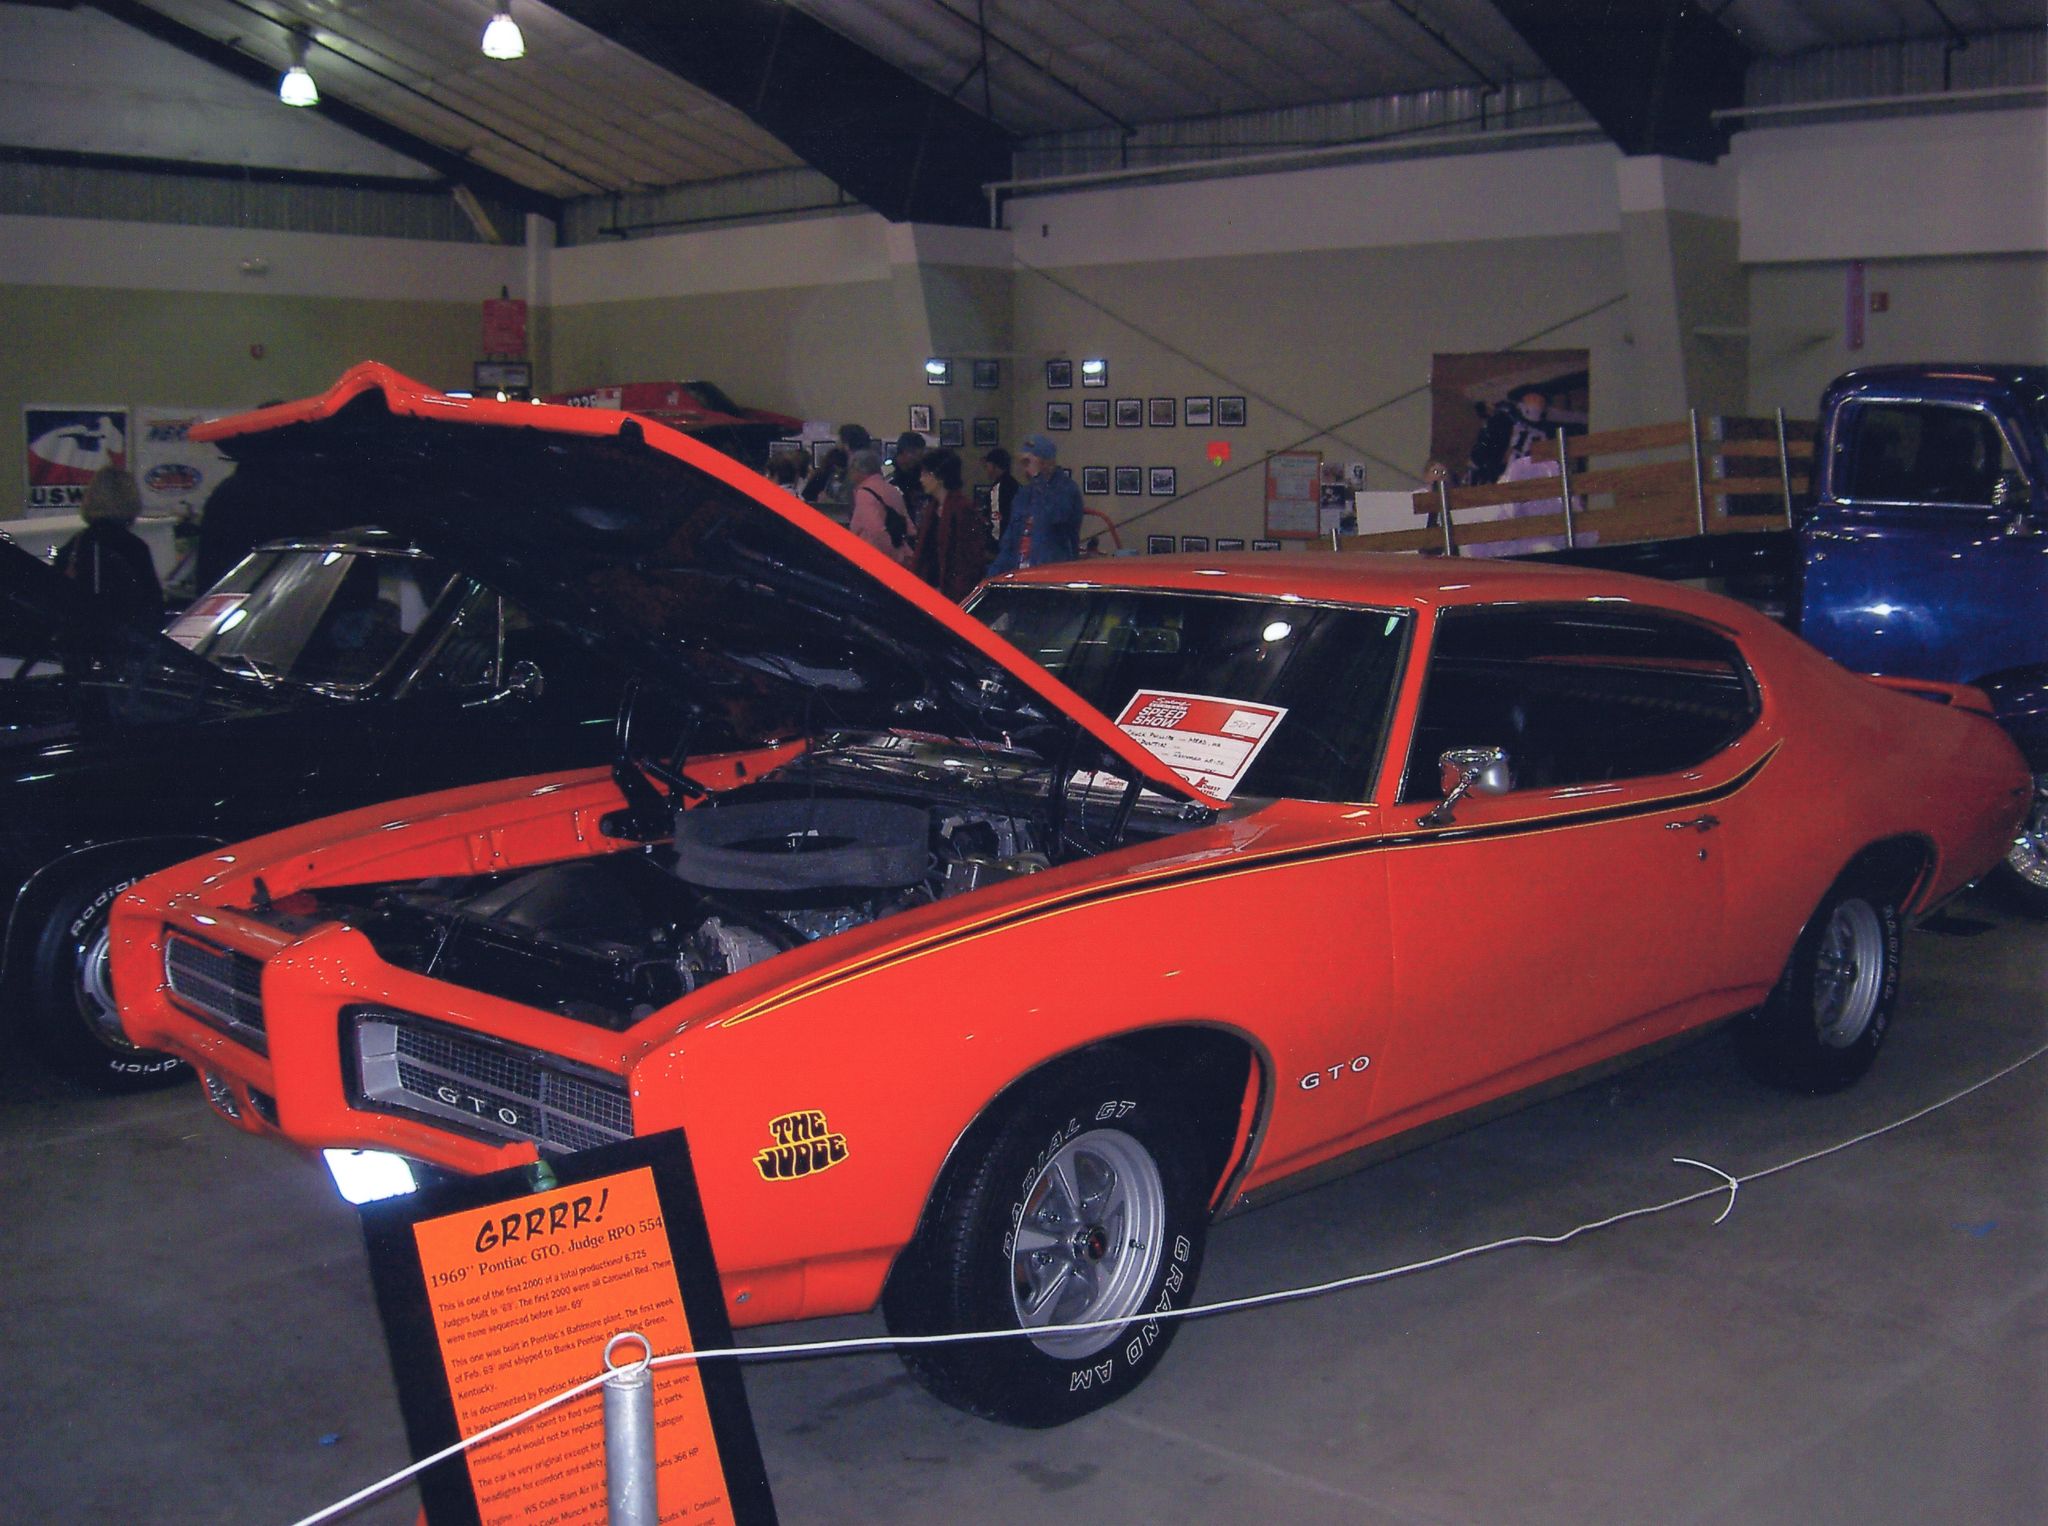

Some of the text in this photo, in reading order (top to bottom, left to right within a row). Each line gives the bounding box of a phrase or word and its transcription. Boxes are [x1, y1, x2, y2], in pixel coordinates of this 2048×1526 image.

[1132, 715, 1180, 728] SHOW
[1139, 706, 1187, 720] SPEED
[1300, 1055, 1370, 1091] GTO
[438, 1086, 518, 1125] GTO
[769, 1109, 828, 1146] THE
[752, 1132, 850, 1181] JUDGE
[1002, 1100, 1136, 1259] RADIAL GT
[474, 1188, 609, 1253] GRRRR!
[478, 1250, 528, 1276] Pontiac
[566, 1230, 605, 1254] Judge
[607, 1222, 636, 1241] RPO
[638, 1215, 663, 1233] 554
[438, 1300, 455, 1313] This
[456, 1298, 464, 1308] is
[466, 1296, 481, 1305] one
[481, 1291, 490, 1301] of
[491, 1287, 504, 1298] the
[505, 1282, 521, 1294] first
[521, 1276, 543, 1290] 2000
[518, 1296, 533, 1307] The
[533, 1291, 549, 1303] first
[550, 1285, 571, 1298] 2000
[1069, 1234, 1191, 1392] GRAND AM
[451, 1356, 467, 1368] This
[625, 1306, 638, 1317] The
[639, 1301, 654, 1313] first
